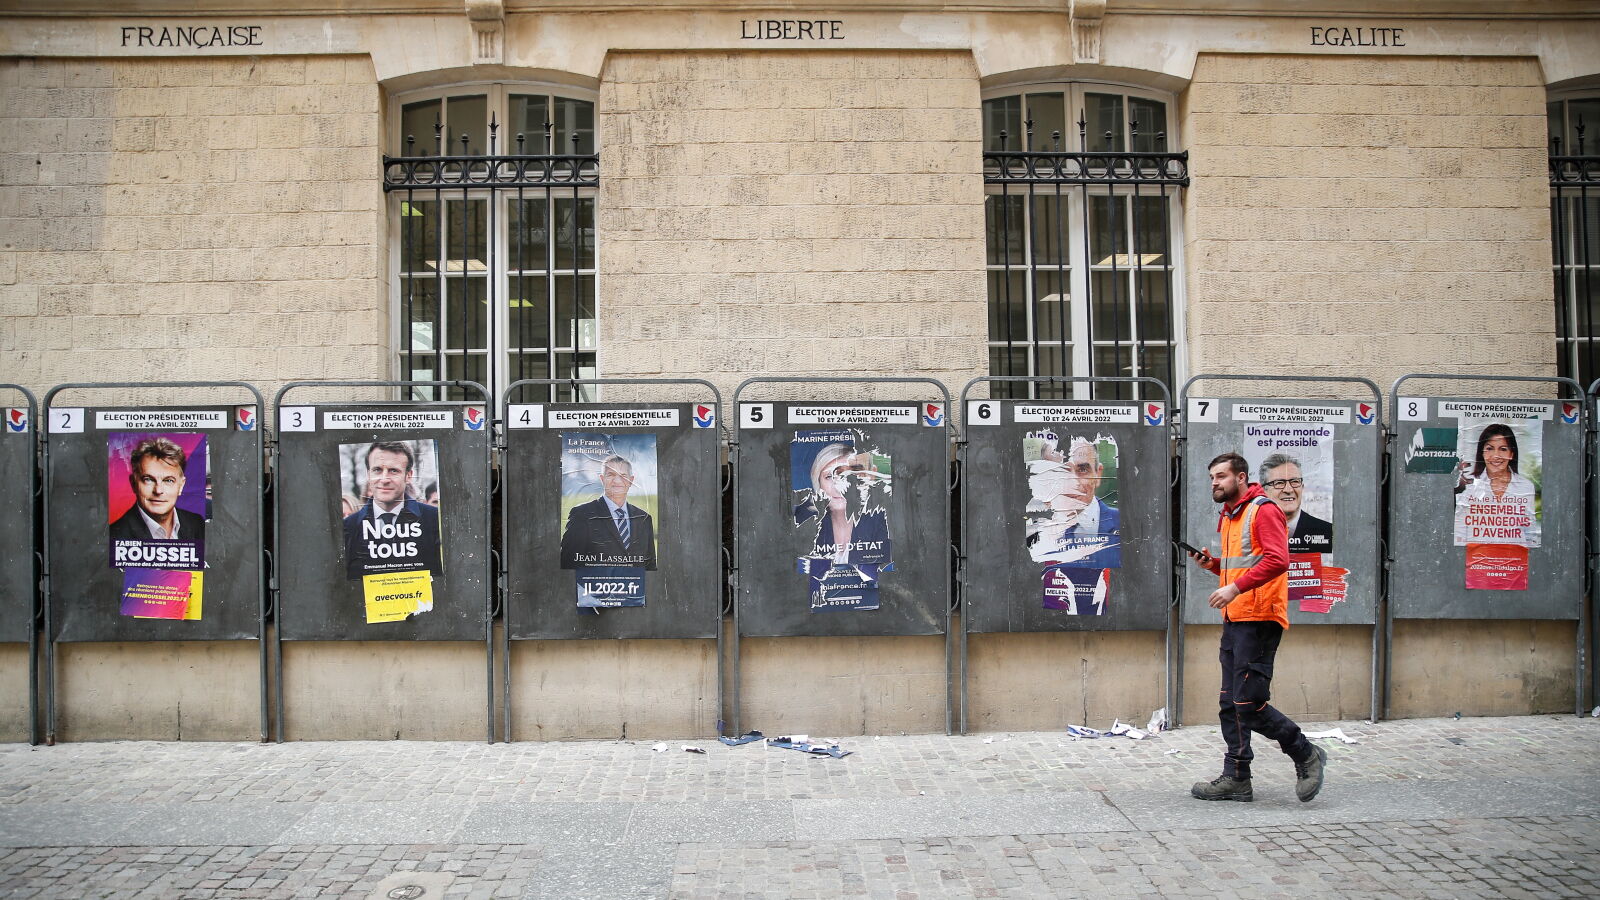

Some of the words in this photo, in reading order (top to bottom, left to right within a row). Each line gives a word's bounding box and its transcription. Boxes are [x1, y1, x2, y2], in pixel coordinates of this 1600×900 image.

[120, 26, 264, 48] FRANÇAISE
[741, 20, 845, 40] LIBERTE
[1310, 26, 1406, 46] EGALITE
[600, 411, 671, 419] PRÉSIDENTIELLE
[750, 407, 763, 422] 5
[978, 404, 991, 419] 6
[1198, 402, 1210, 416] 7
[1239, 406, 1278, 414] ÉLECTION
[1280, 407, 1344, 416] PRÉSIDENTIELLE
[1408, 402, 1417, 416] 8
[1485, 404, 1547, 413] PRÉSIDENTIELLE
[61, 414, 71, 428] 2
[292, 412, 302, 427] 3
[519, 410, 531, 425] 4
[1247, 427, 1261, 436] Un
[1263, 428, 1290, 436] autre
[1293, 428, 1330, 436] monde
[1276, 438, 1318, 449] possible
[1470, 505, 1526, 515] ENSEMBLE
[1465, 516, 1530, 527] CHANGEONS
[363, 520, 422, 540] Nous
[1473, 528, 1521, 538] D'AVENIR
[368, 541, 418, 558] tous
[814, 544, 844, 553] MME
[846, 540, 883, 551] D'ÉTAT
[115, 547, 199, 562] ROUSSEL
[375, 591, 422, 601] avecvous.fr
[583, 582, 639, 596] JL2022.fr
